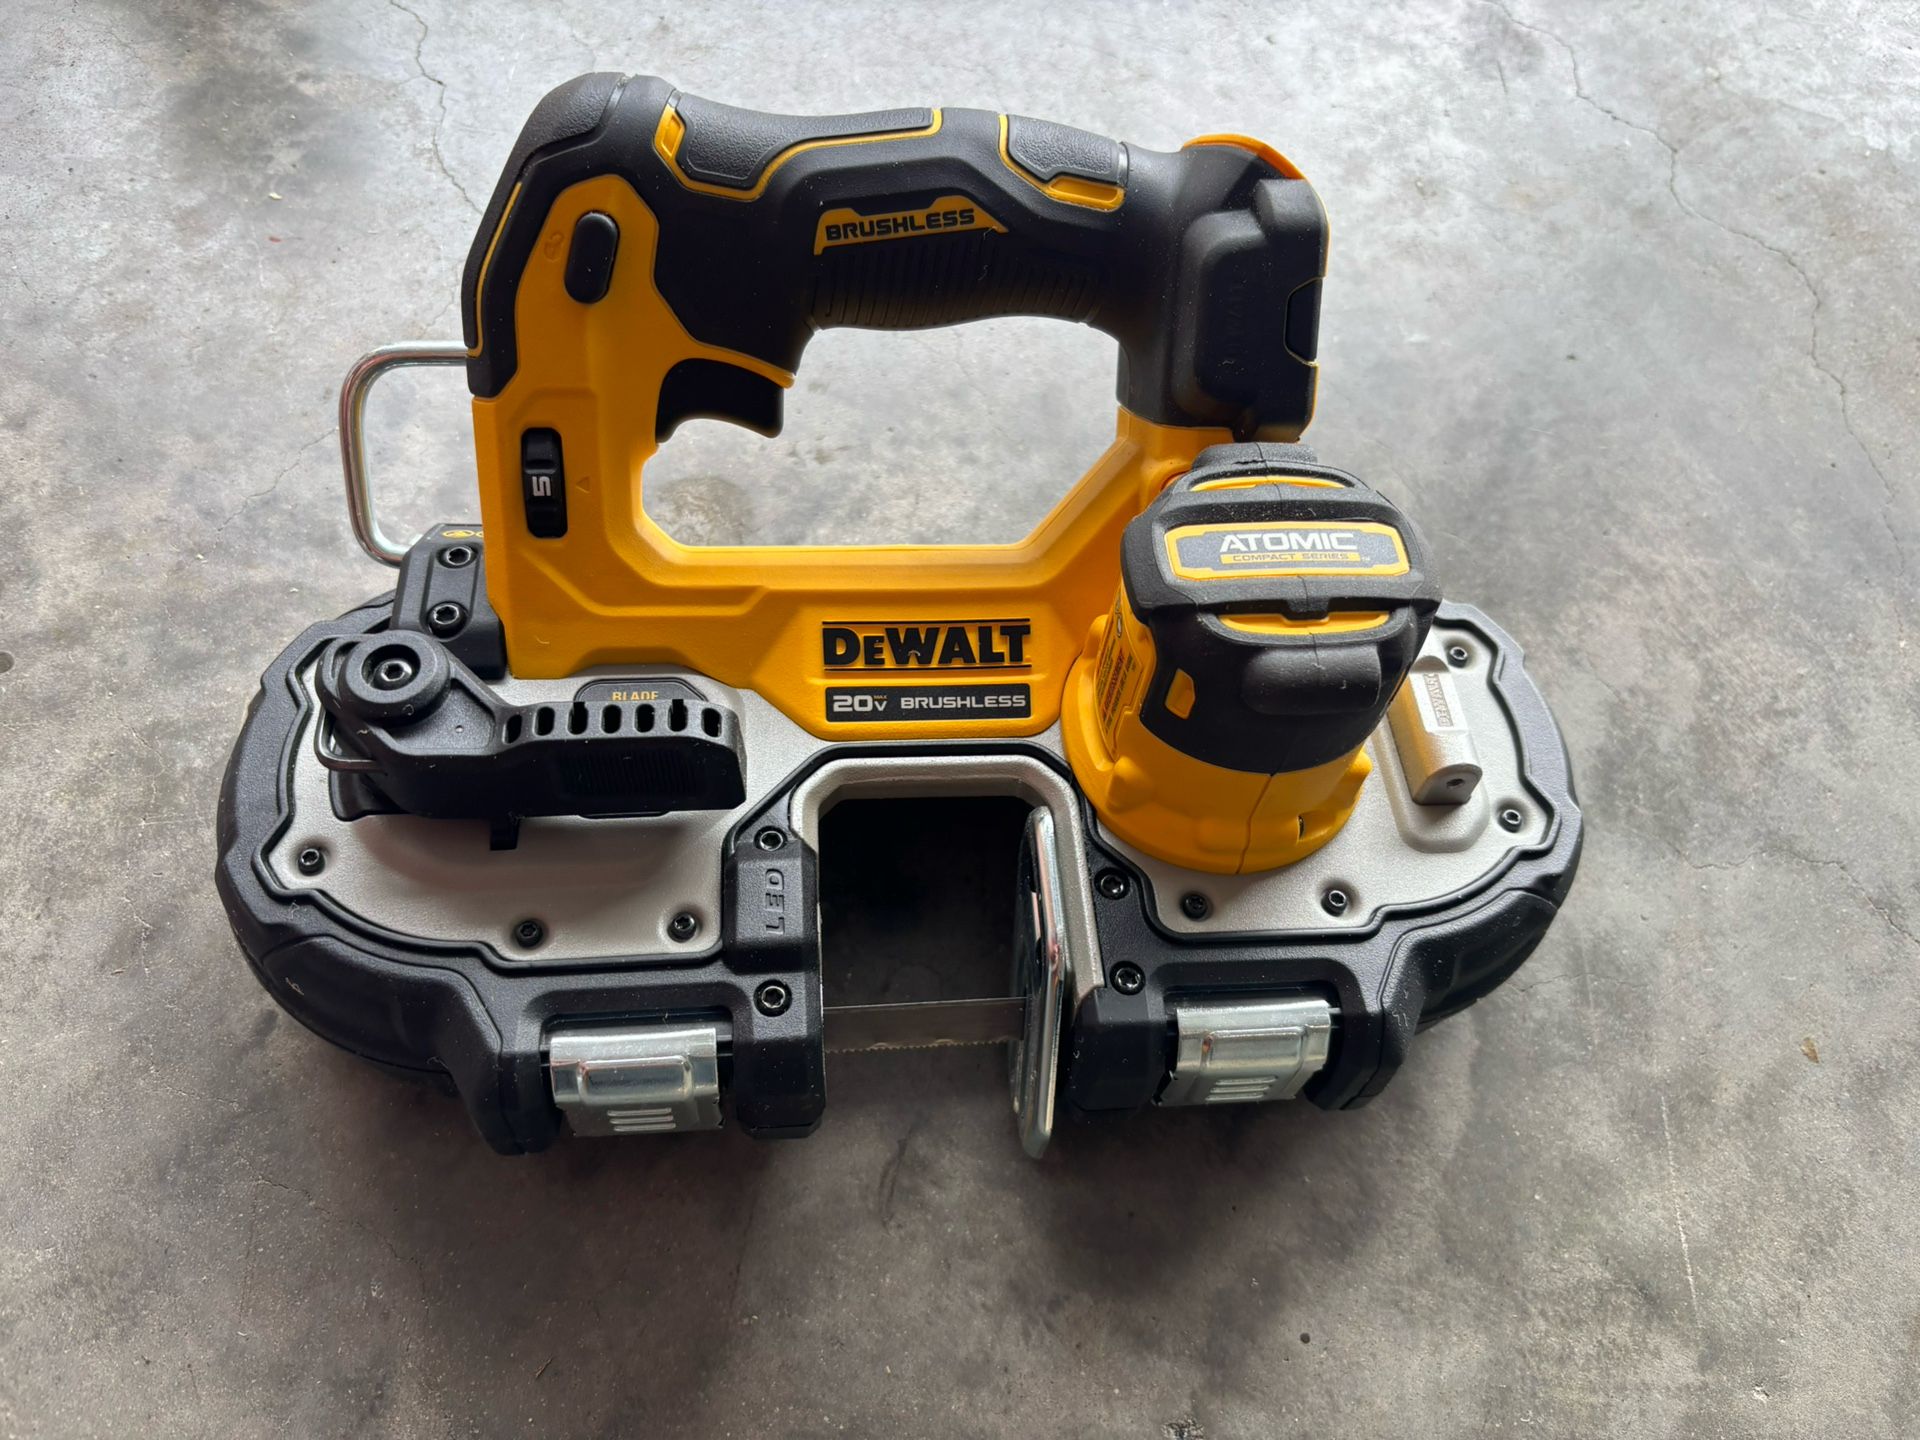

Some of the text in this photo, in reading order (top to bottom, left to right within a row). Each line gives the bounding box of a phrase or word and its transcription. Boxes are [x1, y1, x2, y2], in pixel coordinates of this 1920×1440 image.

[825, 208, 975, 240] BRUSHLESS
[1219, 532, 1358, 552] ATOMIC
[1233, 553, 1296, 562] COMPACT
[822, 624, 1031, 665] DEWALT
[900, 694, 1026, 709] BRUSHLESS
[765, 868, 785, 935] LED
